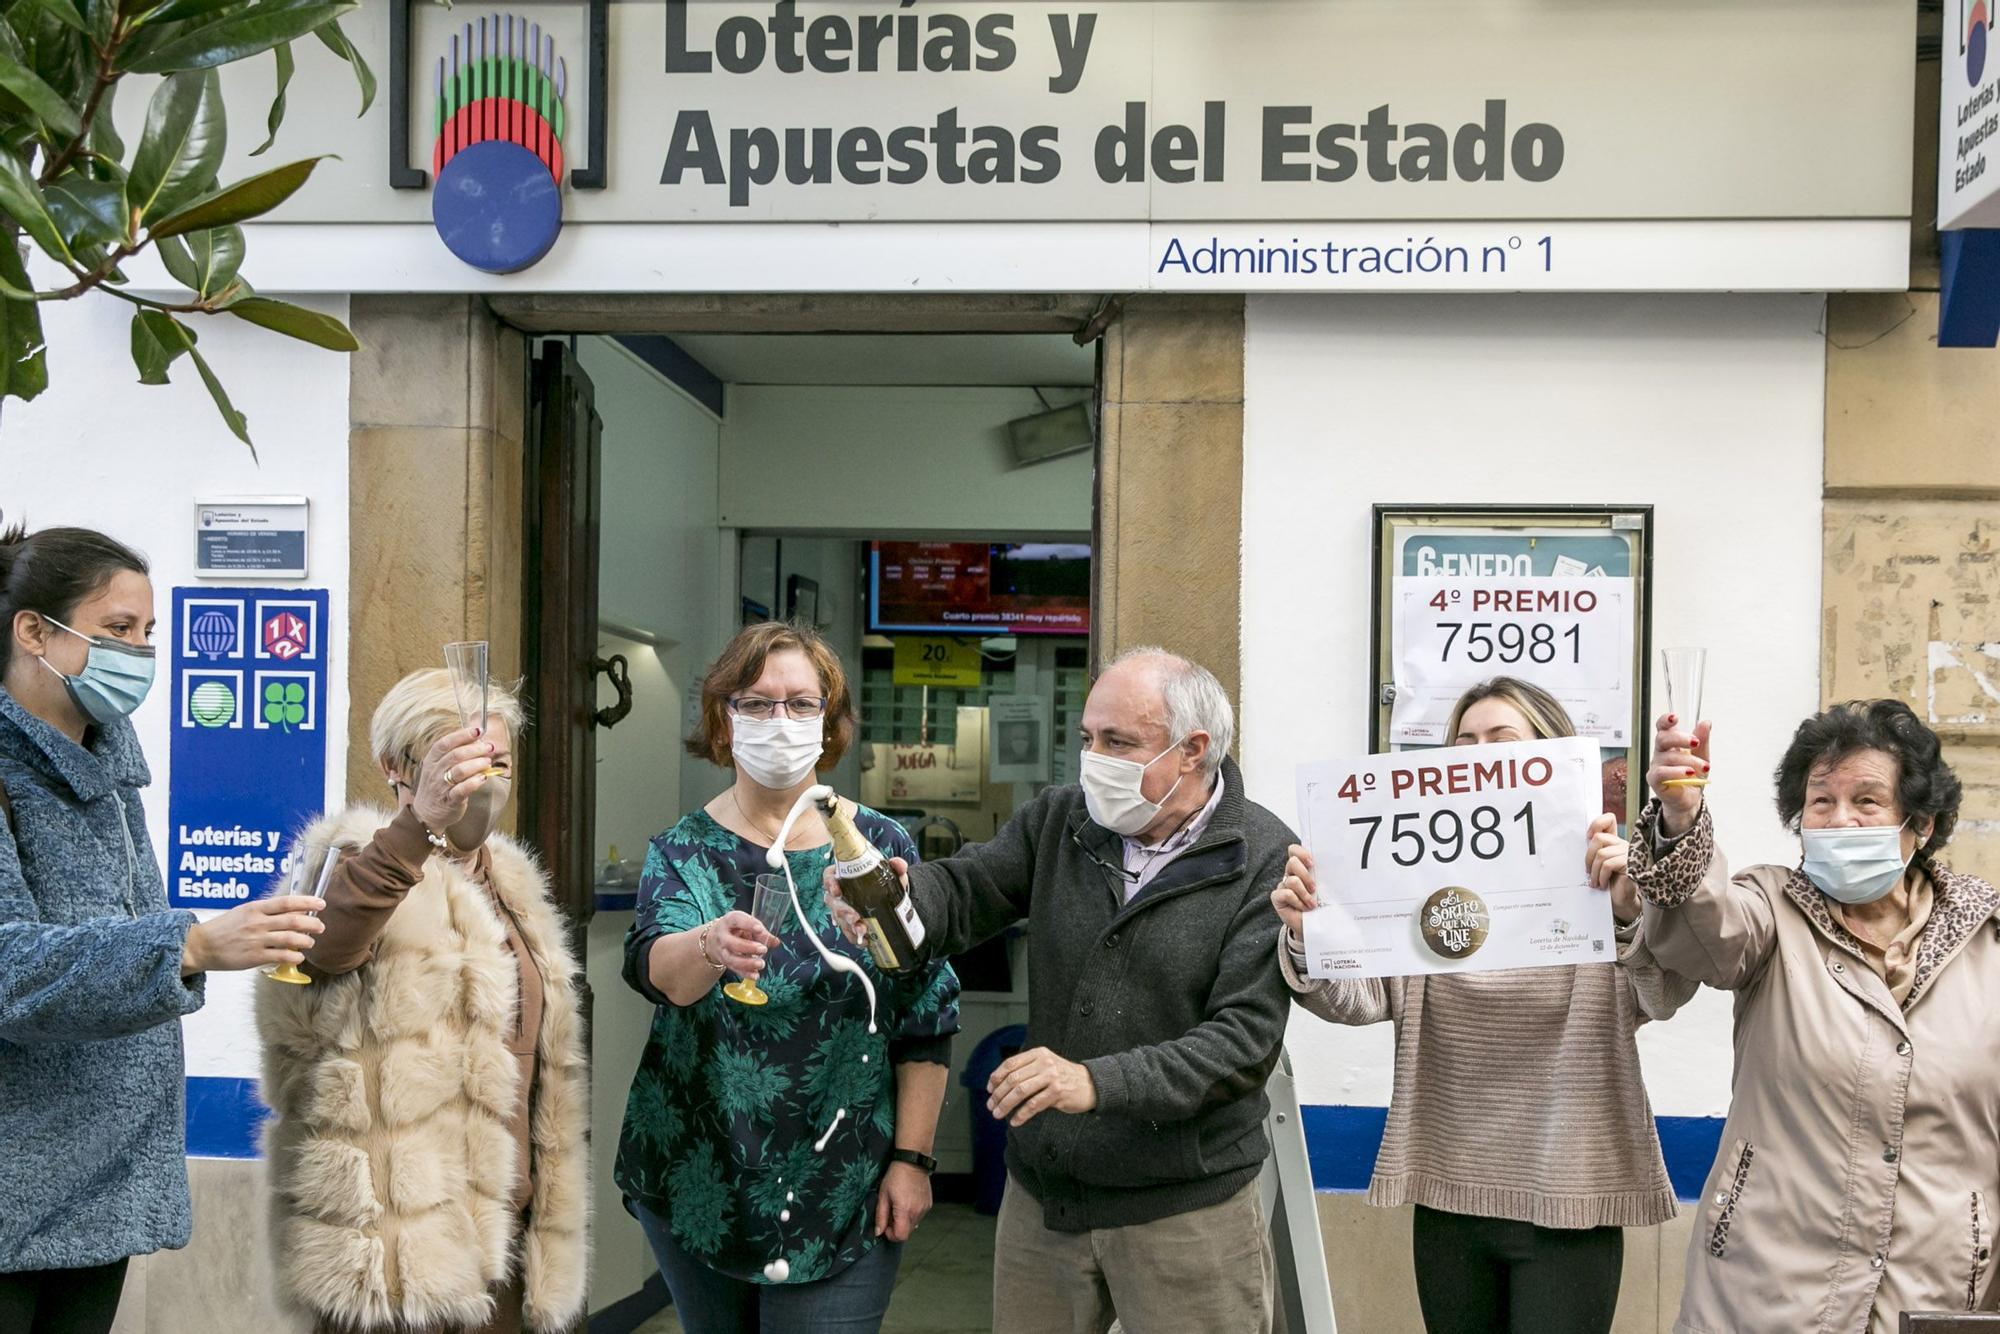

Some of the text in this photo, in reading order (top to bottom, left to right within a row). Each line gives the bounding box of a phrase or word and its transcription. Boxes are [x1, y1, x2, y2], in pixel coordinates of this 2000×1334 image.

[665, 0, 1098, 94] Loterías y
[1957, 82, 1994, 128] Loterías
[659, 99, 1564, 207] Apuestas del Estado
[1956, 113, 1999, 162] Apuestas
[1955, 152, 1986, 193] Estado
[1157, 236, 1468, 274] Administración
[1537, 236, 1551, 272] 1
[1417, 545, 1436, 576] 6
[971, 613, 1000, 623] premio
[1429, 589, 1597, 613] 4º PREMIO
[1436, 623, 1580, 664] 75981
[1337, 757, 1553, 803] 4º PREMIO
[179, 824, 281, 852] Loterías y
[1349, 801, 1536, 870] 75981
[179, 850, 275, 877] Apuestas
[178, 877, 250, 899] Estado
